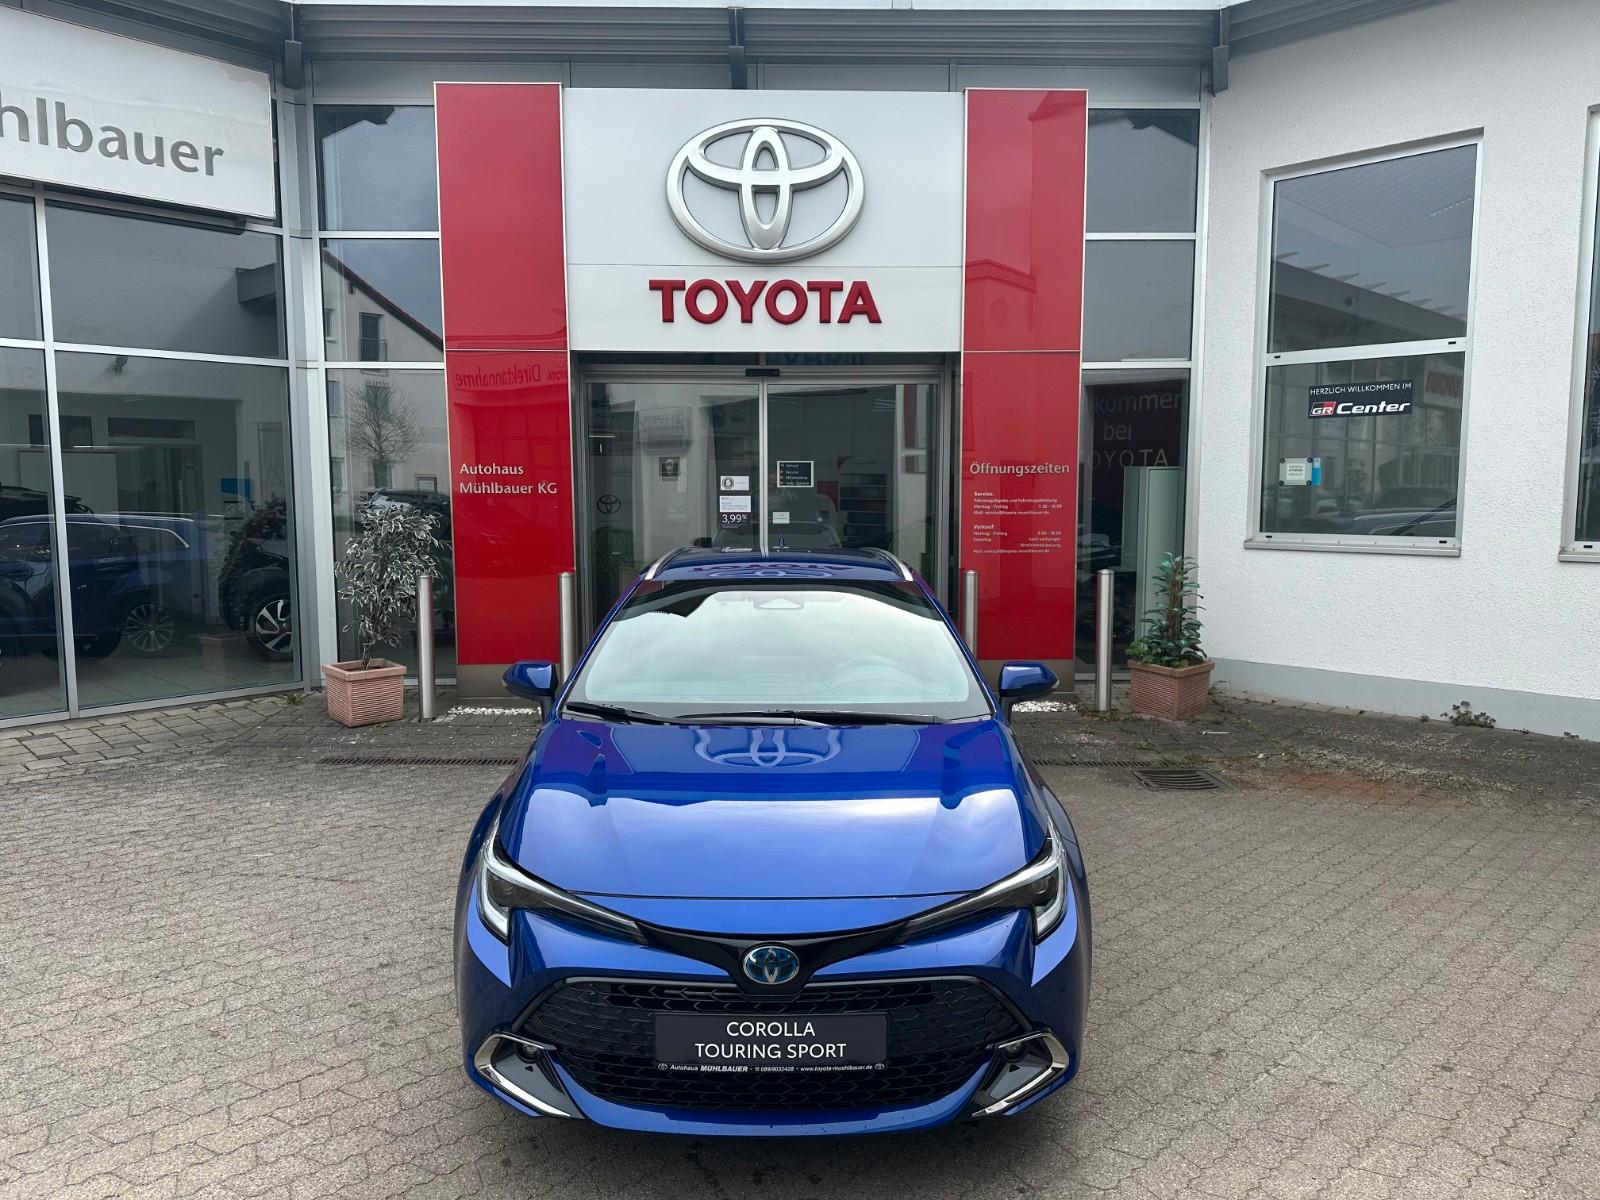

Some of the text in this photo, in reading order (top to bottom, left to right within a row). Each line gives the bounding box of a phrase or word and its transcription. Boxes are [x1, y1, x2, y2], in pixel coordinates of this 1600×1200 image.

[648, 279, 883, 325] TOYOTA
[1311, 382, 1412, 396] HERZLICH WILLKOMMEN IM
[1311, 400, 1411, 416] GR Center
[1103, 419, 1132, 441] bei
[459, 462, 524, 476] Autohaus
[969, 461, 1070, 478] Öffnungszeiten
[459, 480, 558, 494] Mühlbauer KG
[726, 1021, 816, 1038] COROLLA
[694, 1043, 847, 1059] TOURING SPORT
[669, 1064, 699, 1072] Autohaus
[700, 1064, 748, 1073] MÜHLBAUER
